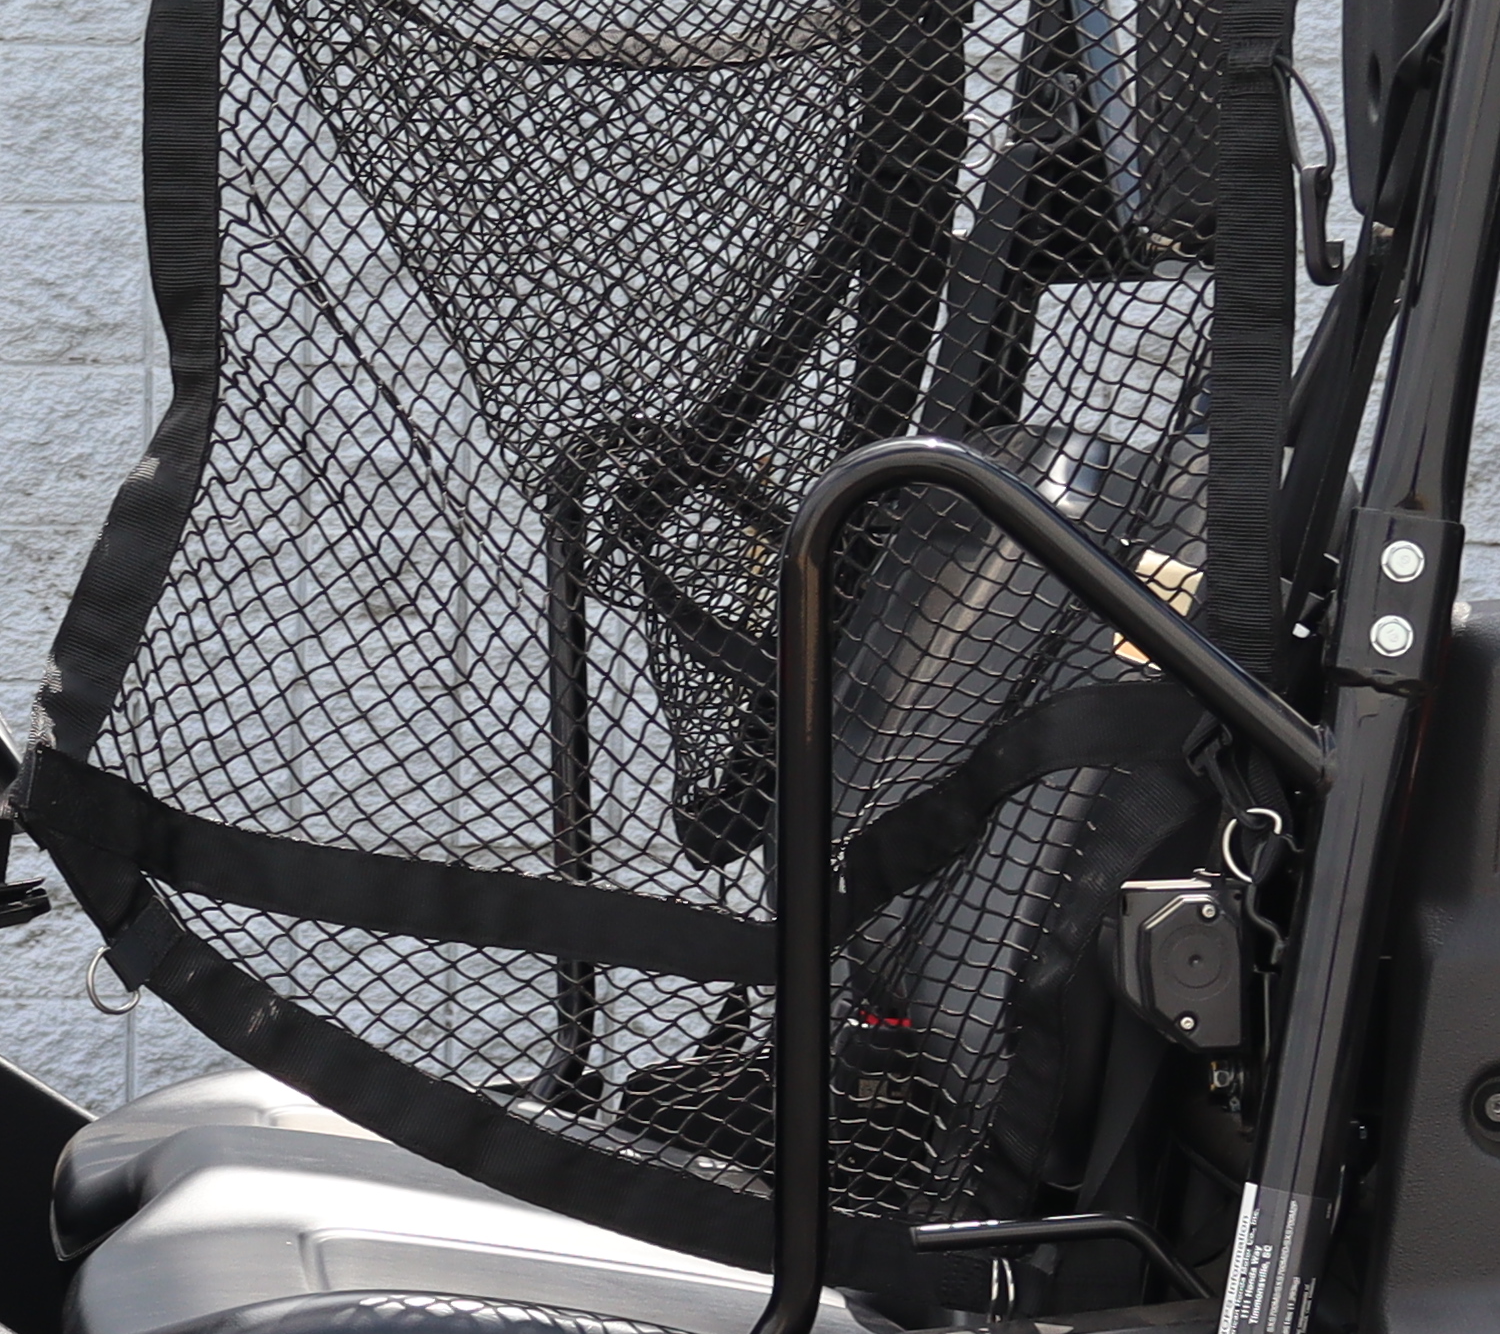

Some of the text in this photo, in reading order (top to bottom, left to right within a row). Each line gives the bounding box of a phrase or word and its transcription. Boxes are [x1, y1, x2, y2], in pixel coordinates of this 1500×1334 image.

[1227, 1215, 1249, 1294] Information
[1250, 1244, 1262, 1265] Way
[1234, 1276, 1246, 1307] Honda
[1244, 1266, 1257, 1297] Honda
